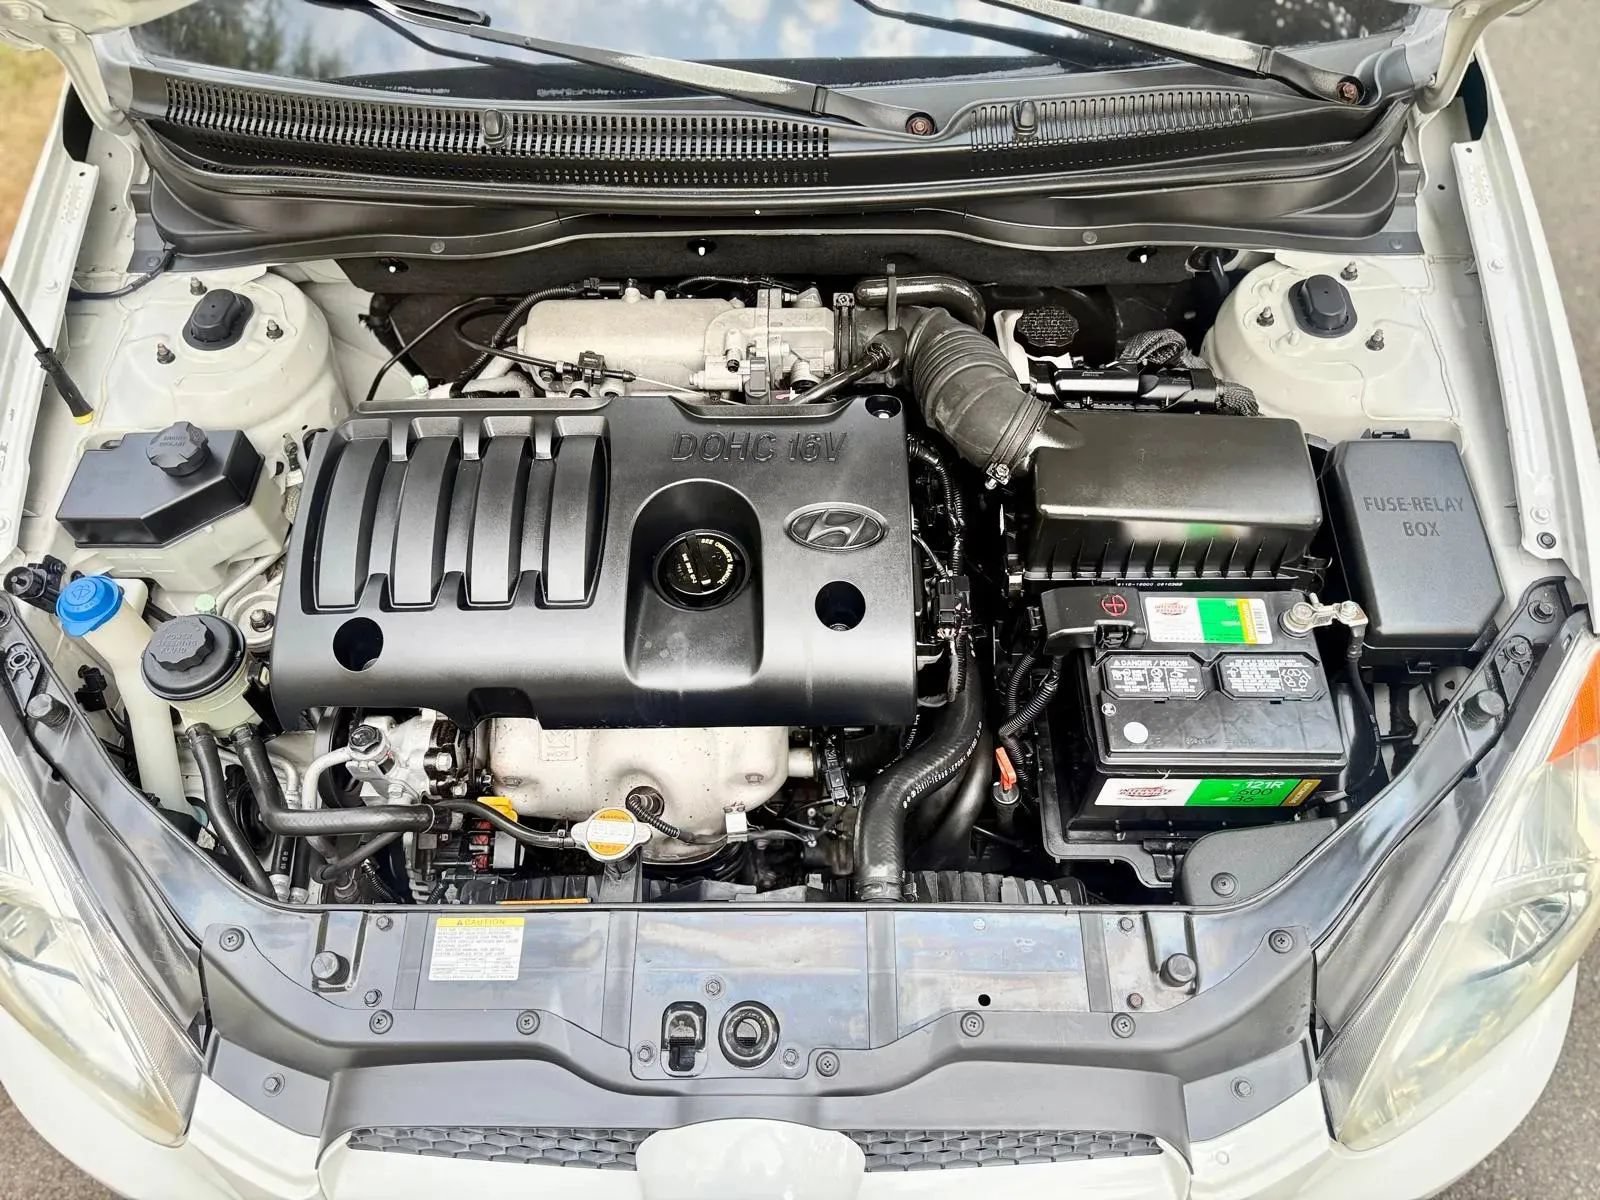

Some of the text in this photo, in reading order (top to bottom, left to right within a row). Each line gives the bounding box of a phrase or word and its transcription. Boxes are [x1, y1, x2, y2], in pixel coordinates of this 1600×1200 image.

[671, 431, 848, 462] DOHC 16V
[1363, 496, 1464, 512] FUSE-RELAY
[1402, 521, 1441, 537] BOX
[1239, 788, 1273, 796] 600
[1245, 781, 1285, 789] 121R
